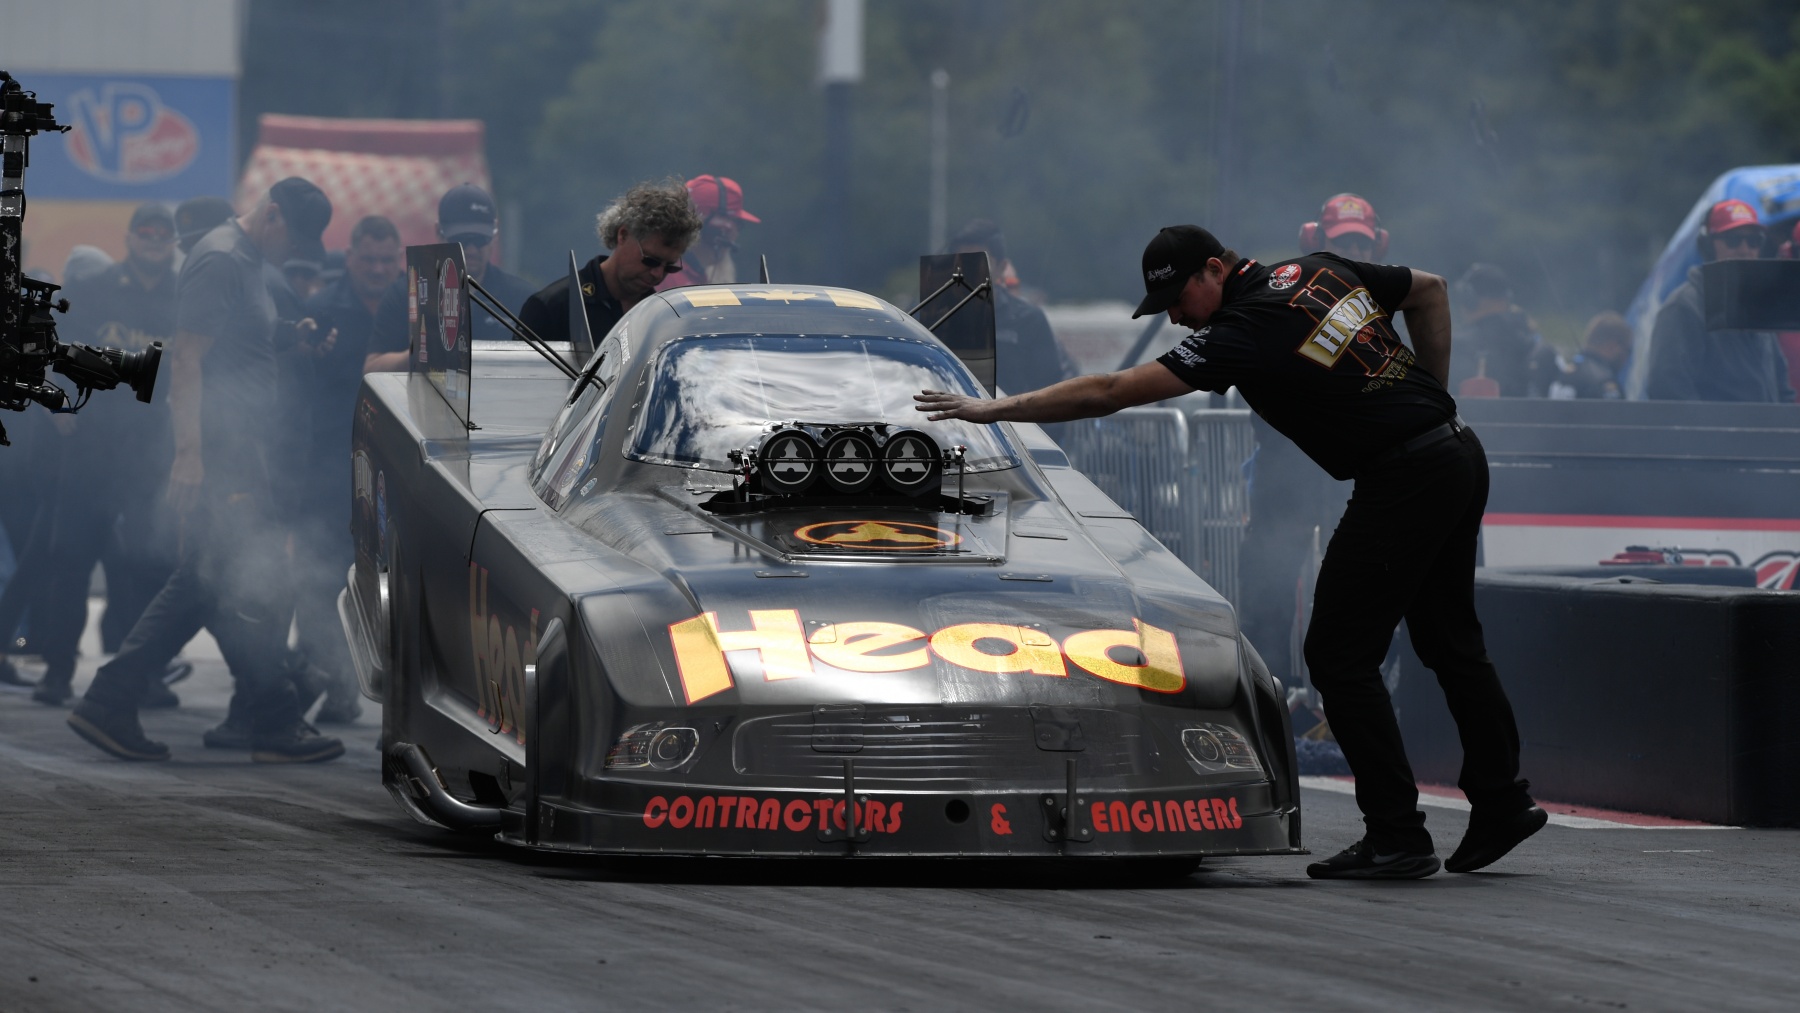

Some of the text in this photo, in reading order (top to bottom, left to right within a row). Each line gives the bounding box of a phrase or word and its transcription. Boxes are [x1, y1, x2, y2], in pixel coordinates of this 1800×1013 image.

[68, 82, 161, 172] VP
[668, 608, 1186, 705] Head
[642, 796, 1243, 835] CONTRACTORS & ENGINEERS
